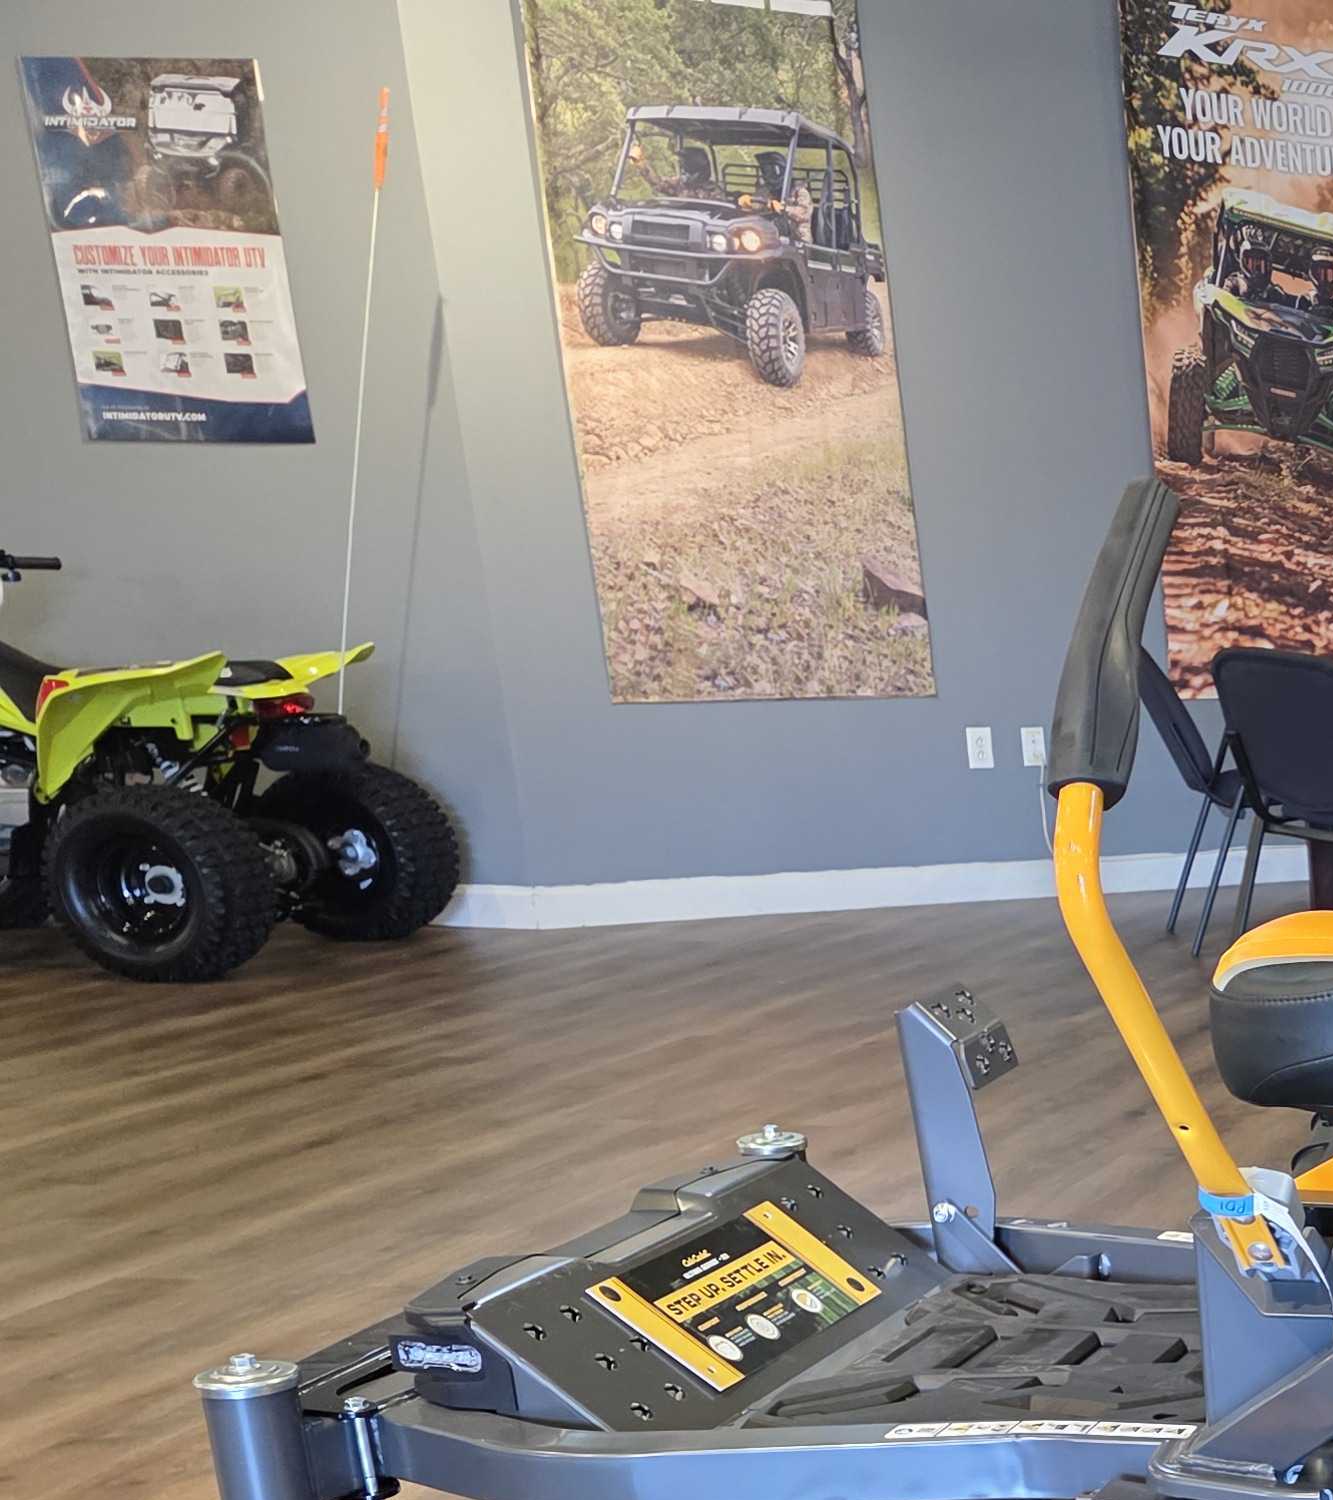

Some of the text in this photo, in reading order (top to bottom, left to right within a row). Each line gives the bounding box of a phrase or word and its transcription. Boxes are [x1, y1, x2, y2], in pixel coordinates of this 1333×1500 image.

[1168, 1, 1268, 32] TERYX
[44, 115, 137, 128] INTIMIDATOR
[1179, 87, 1244, 127] YOUR
[1156, 124, 1223, 165] YOUR
[72, 244, 266, 268] CUSTOMIZE YOUR INTIMIDATOR UTV
[667, 1291, 702, 1316] STEP
[720, 1258, 770, 1287] SETTLE
